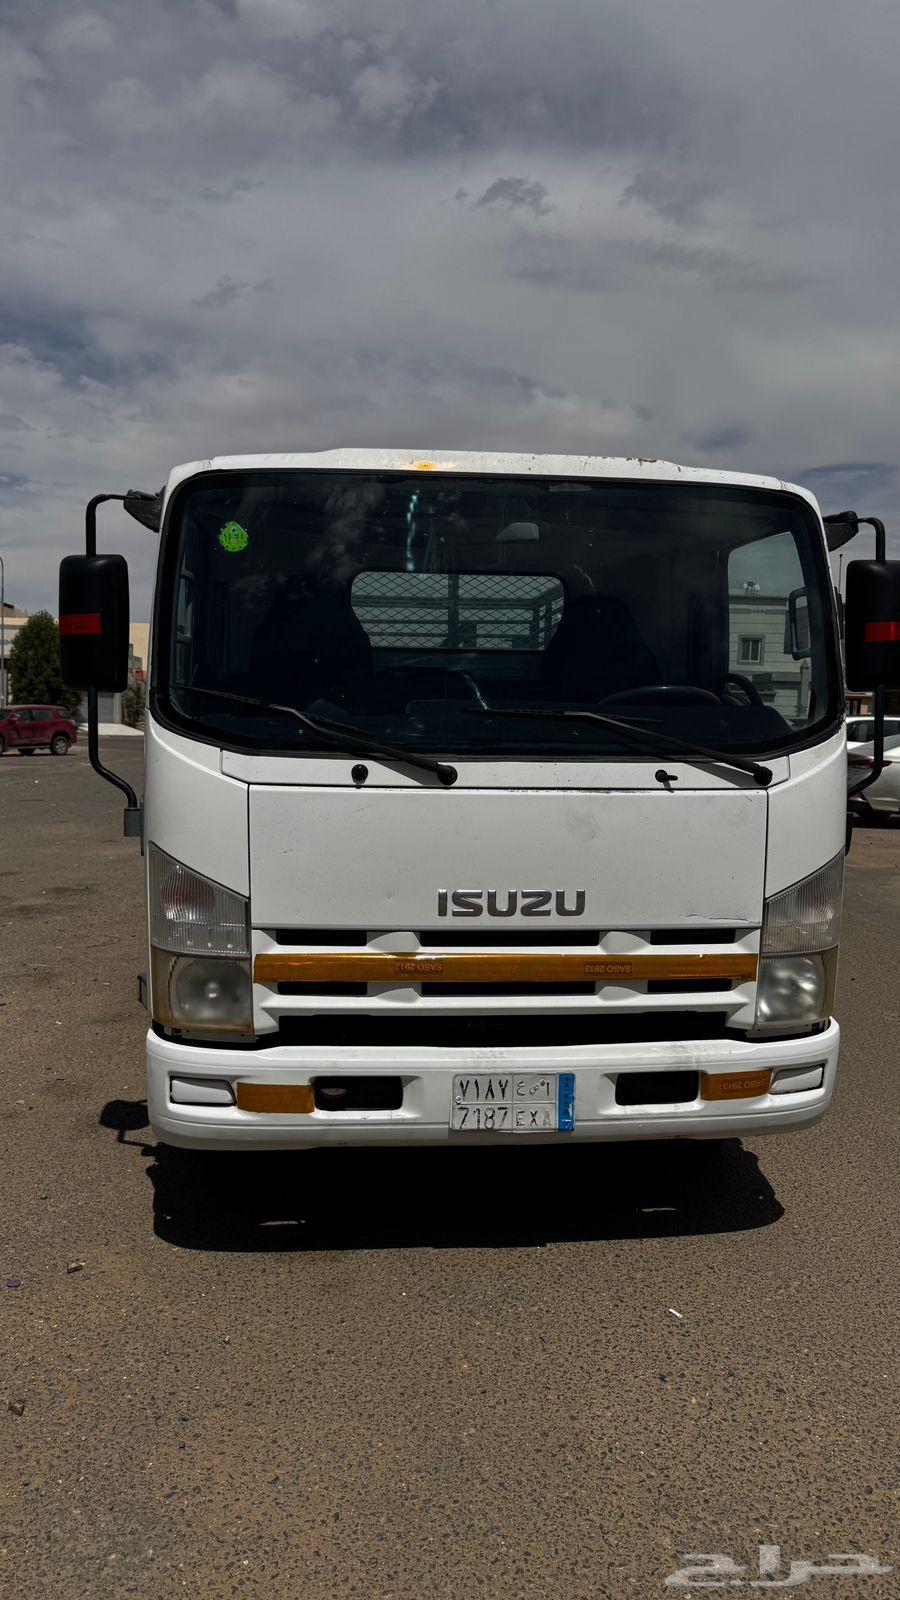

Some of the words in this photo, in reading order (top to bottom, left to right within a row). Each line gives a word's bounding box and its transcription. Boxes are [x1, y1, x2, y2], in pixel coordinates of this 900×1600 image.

[437, 888, 586, 917] ISUZU
[394, 962, 416, 971] 2913
[417, 962, 443, 971] SASO
[585, 964, 605, 973] 2913
[606, 964, 632, 973] SASO
[459, 1078, 509, 1101] ٧١٨٧
[457, 1106, 509, 1130] 7187
[516, 1109, 552, 1127] EXA
